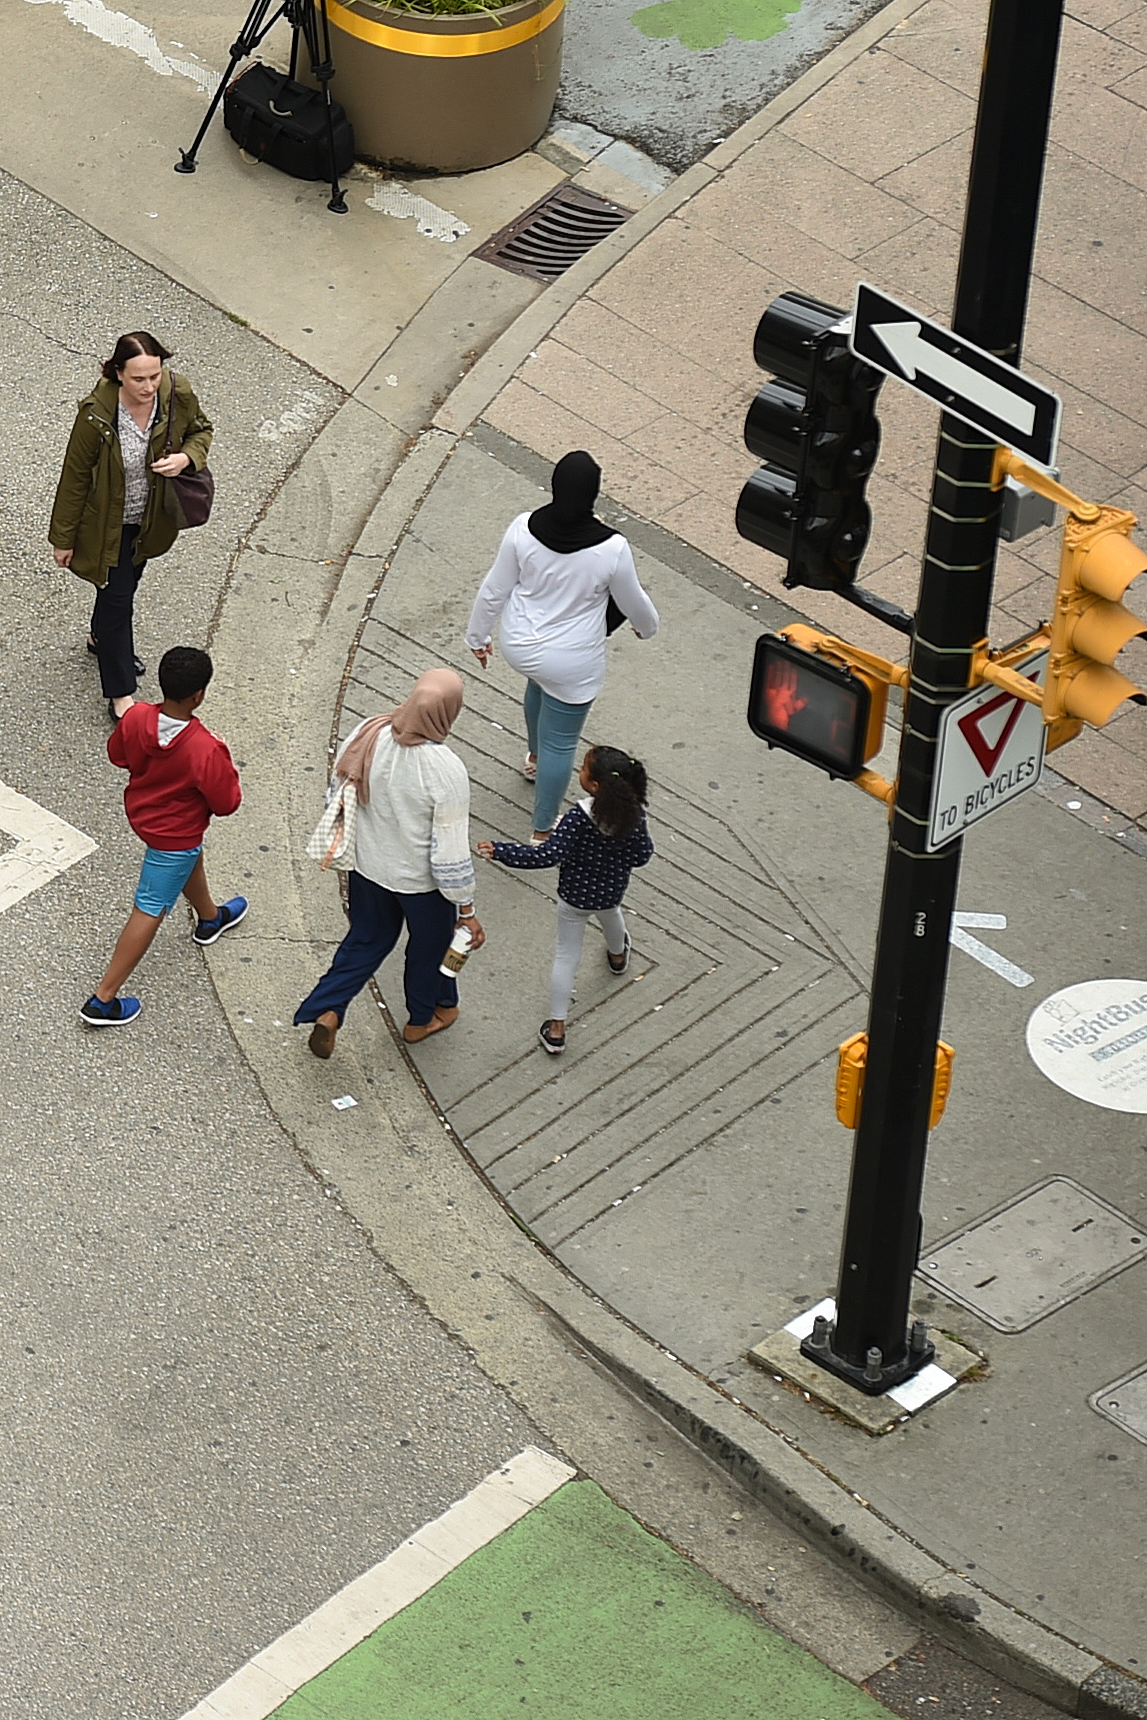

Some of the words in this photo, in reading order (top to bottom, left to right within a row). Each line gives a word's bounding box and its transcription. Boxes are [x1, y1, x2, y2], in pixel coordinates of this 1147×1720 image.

[940, 806, 958, 831] TO
[964, 756, 1036, 816] BICYCLES
[914, 911, 927, 937] 28
